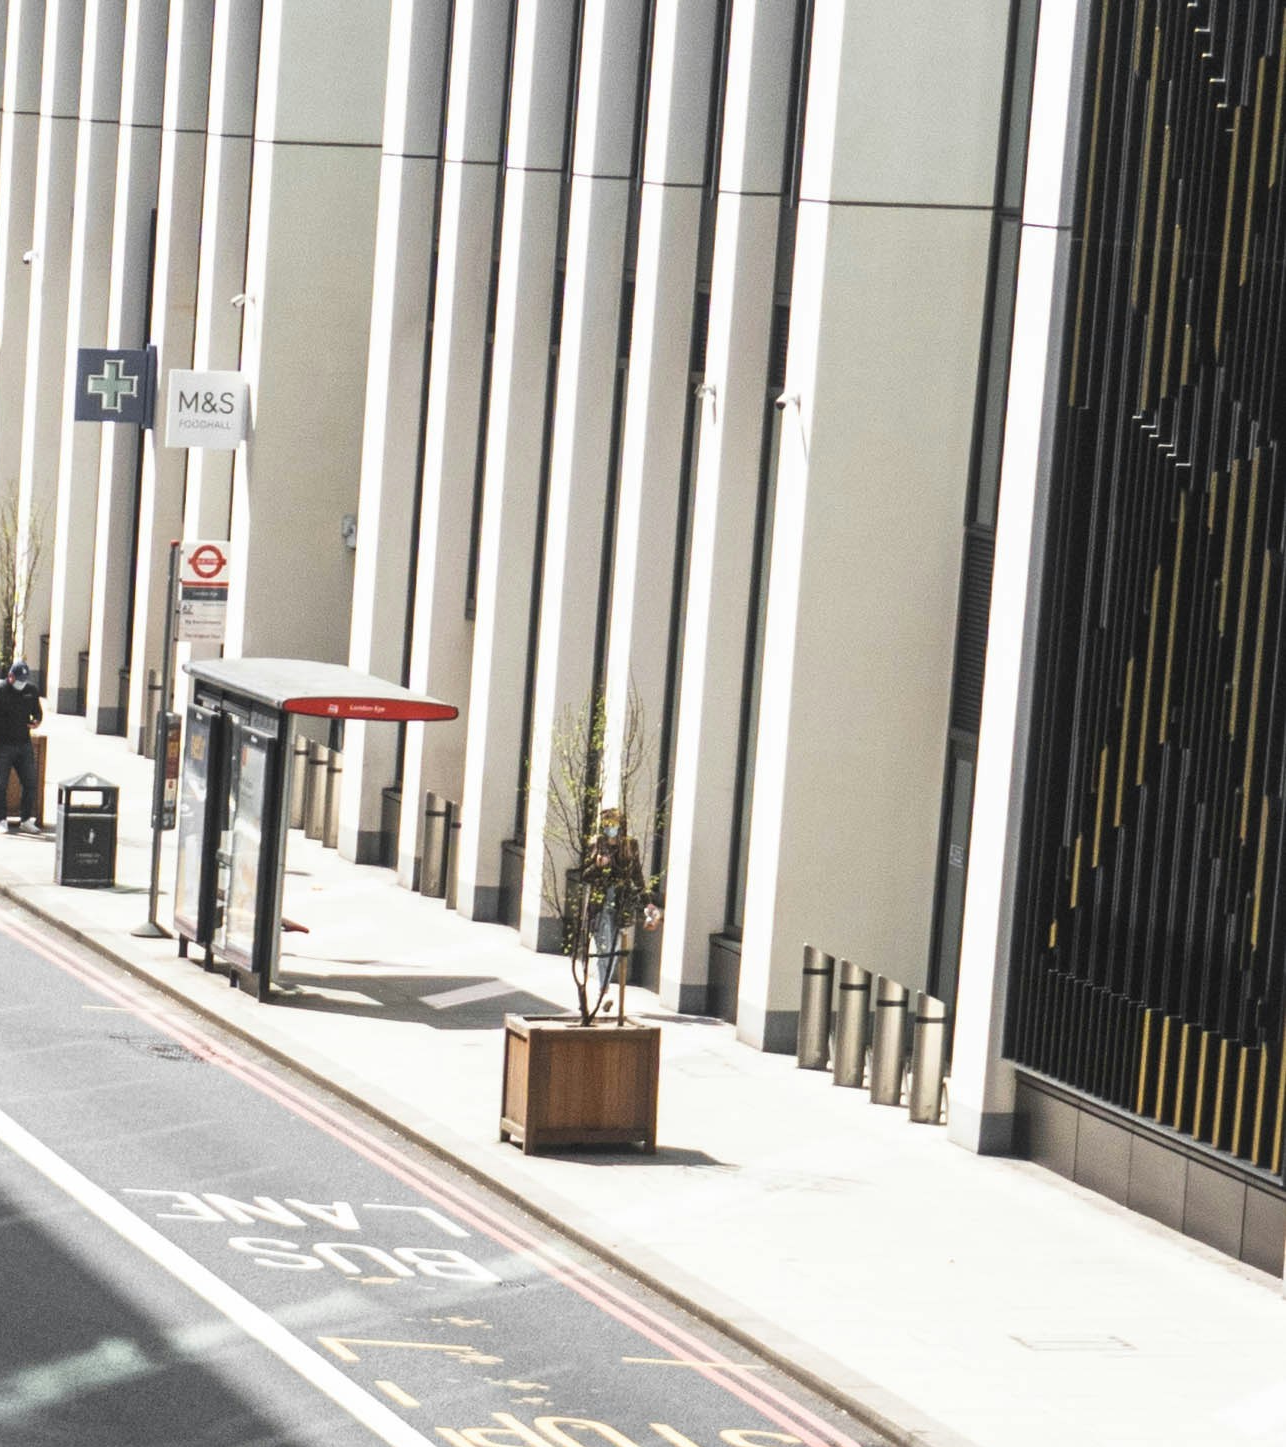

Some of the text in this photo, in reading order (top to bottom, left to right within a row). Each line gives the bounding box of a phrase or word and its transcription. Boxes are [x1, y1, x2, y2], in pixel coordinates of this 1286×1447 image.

[178, 391, 235, 415] M&S
[179, 418, 232, 430] FOODHALL
[126, 1188, 471, 1238] LANE
[228, 1236, 502, 1284] BUS
